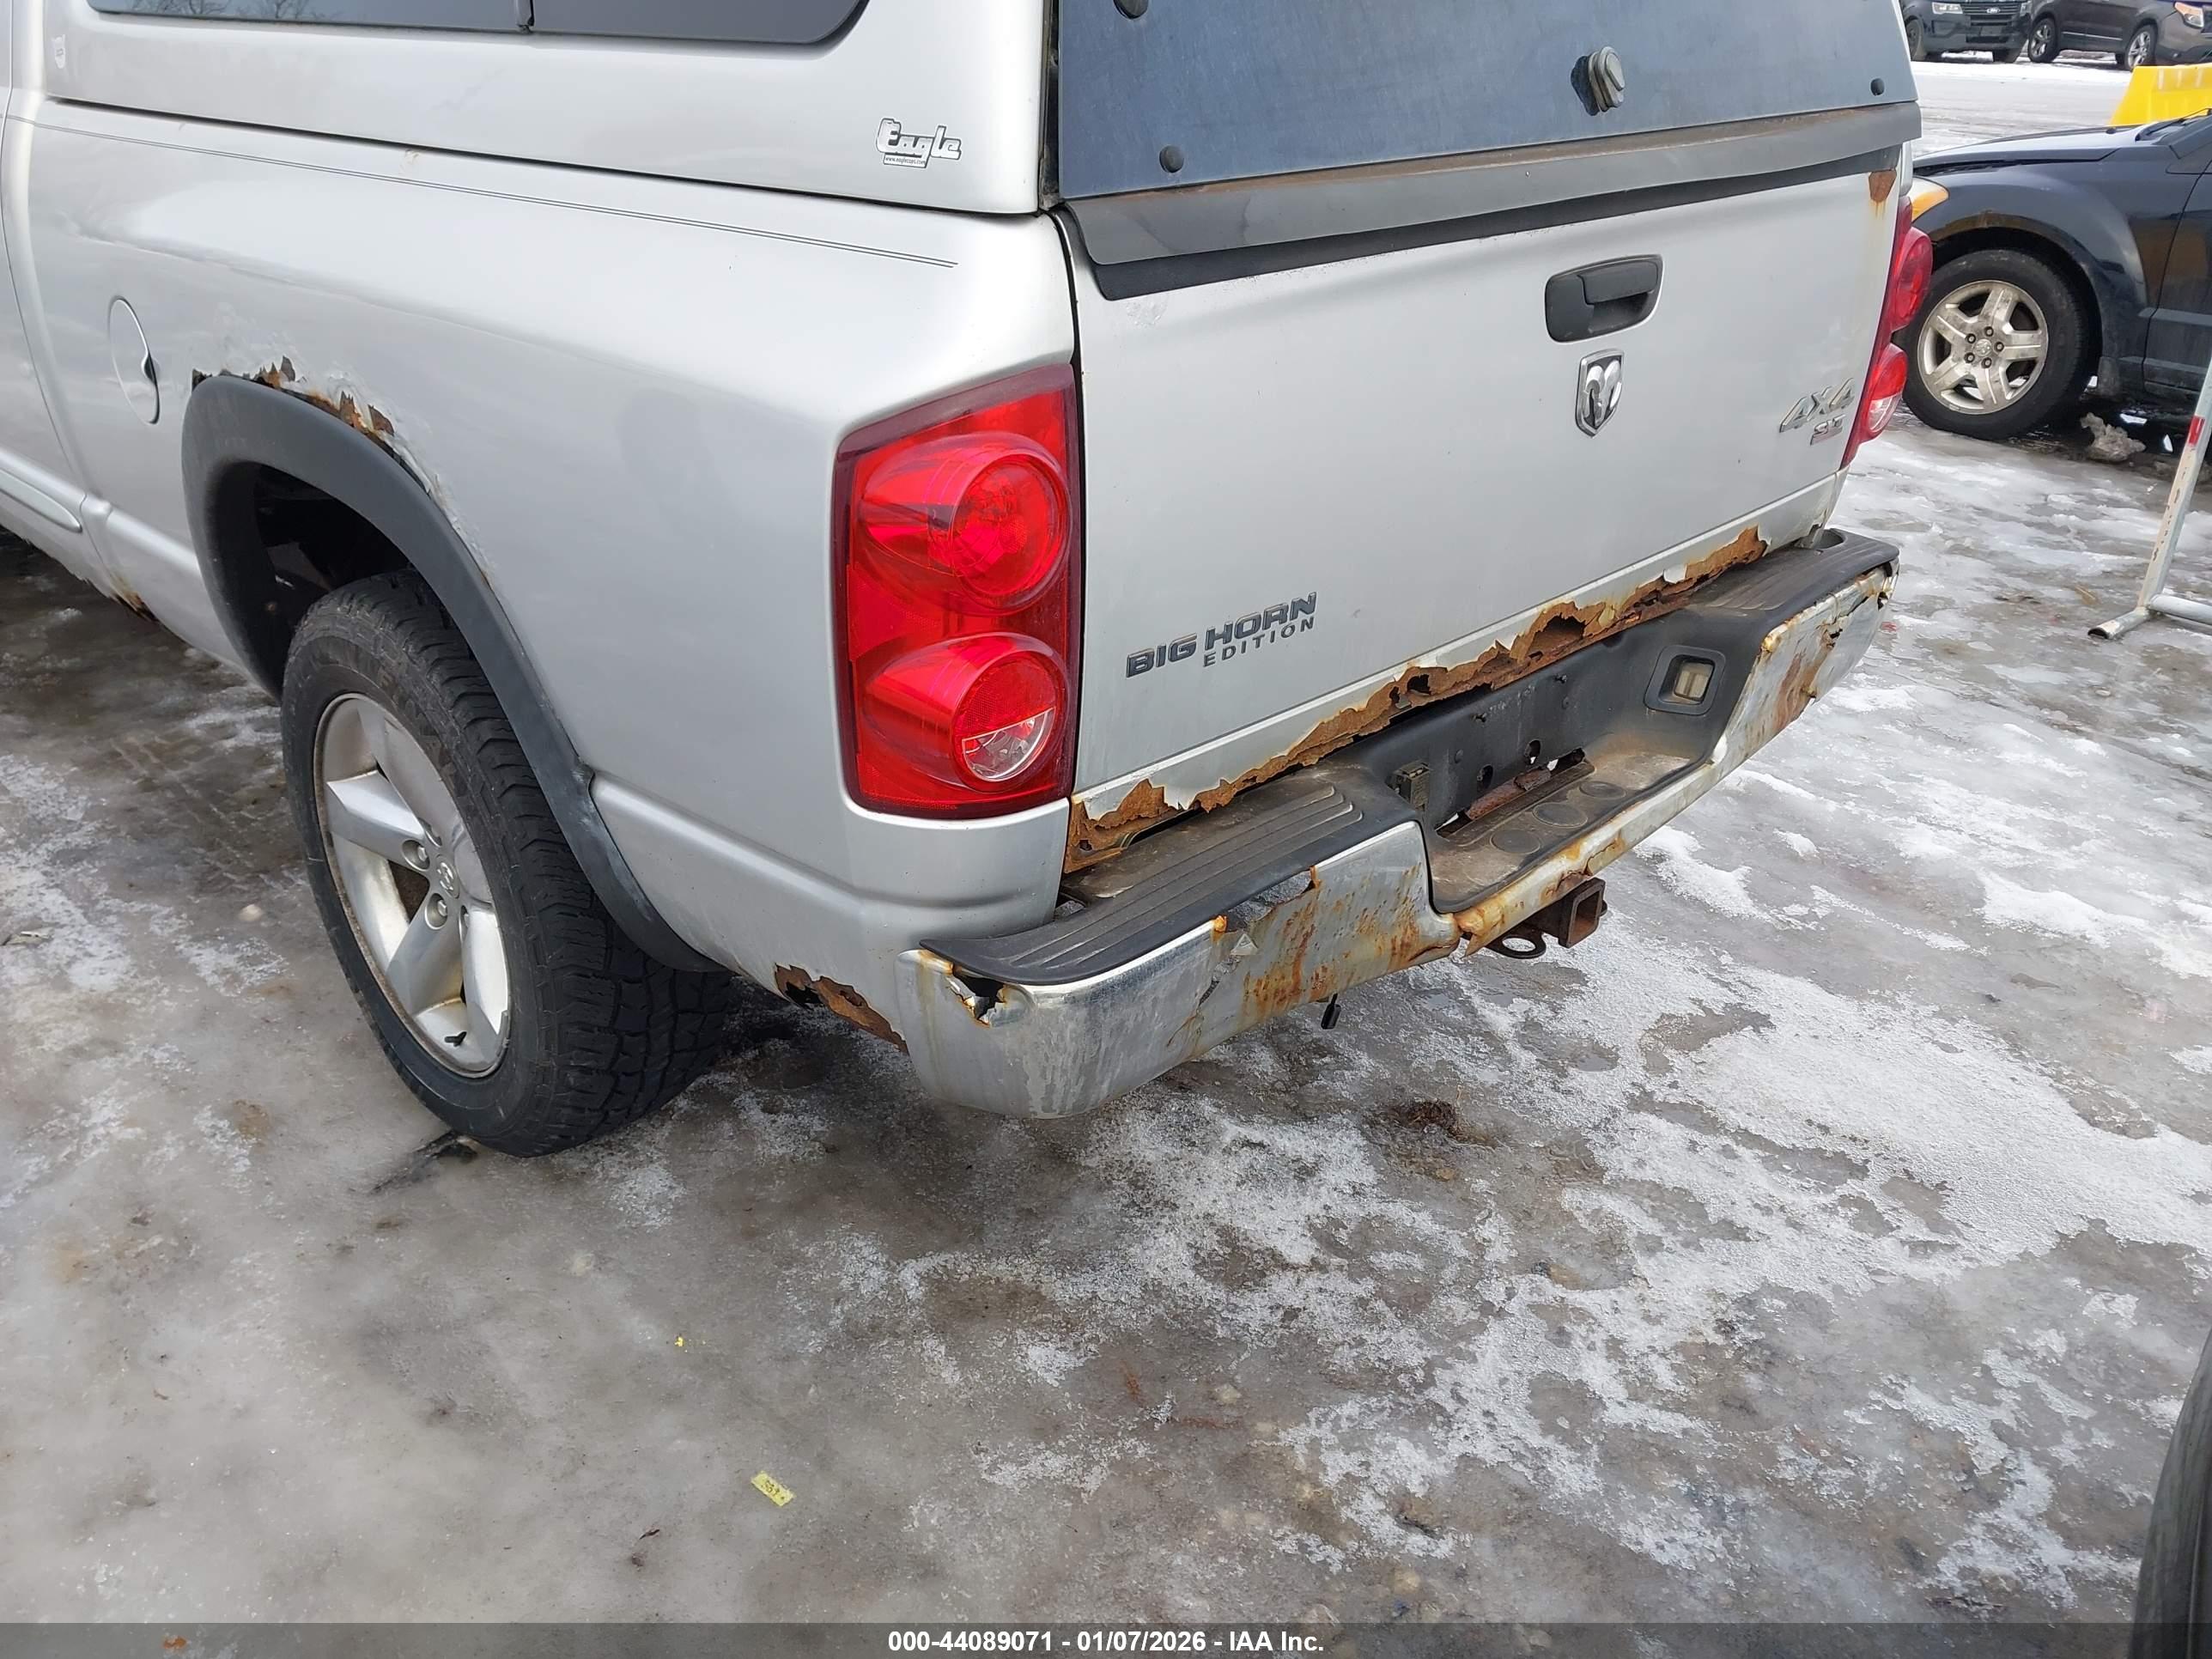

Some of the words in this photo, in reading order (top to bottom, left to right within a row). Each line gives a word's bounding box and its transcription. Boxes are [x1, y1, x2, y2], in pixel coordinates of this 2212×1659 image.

[876, 118, 962, 167] Eagle
[1126, 633, 1198, 678] BIG
[1204, 592, 1317, 651] HORN
[1203, 616, 1315, 667] EDITION
